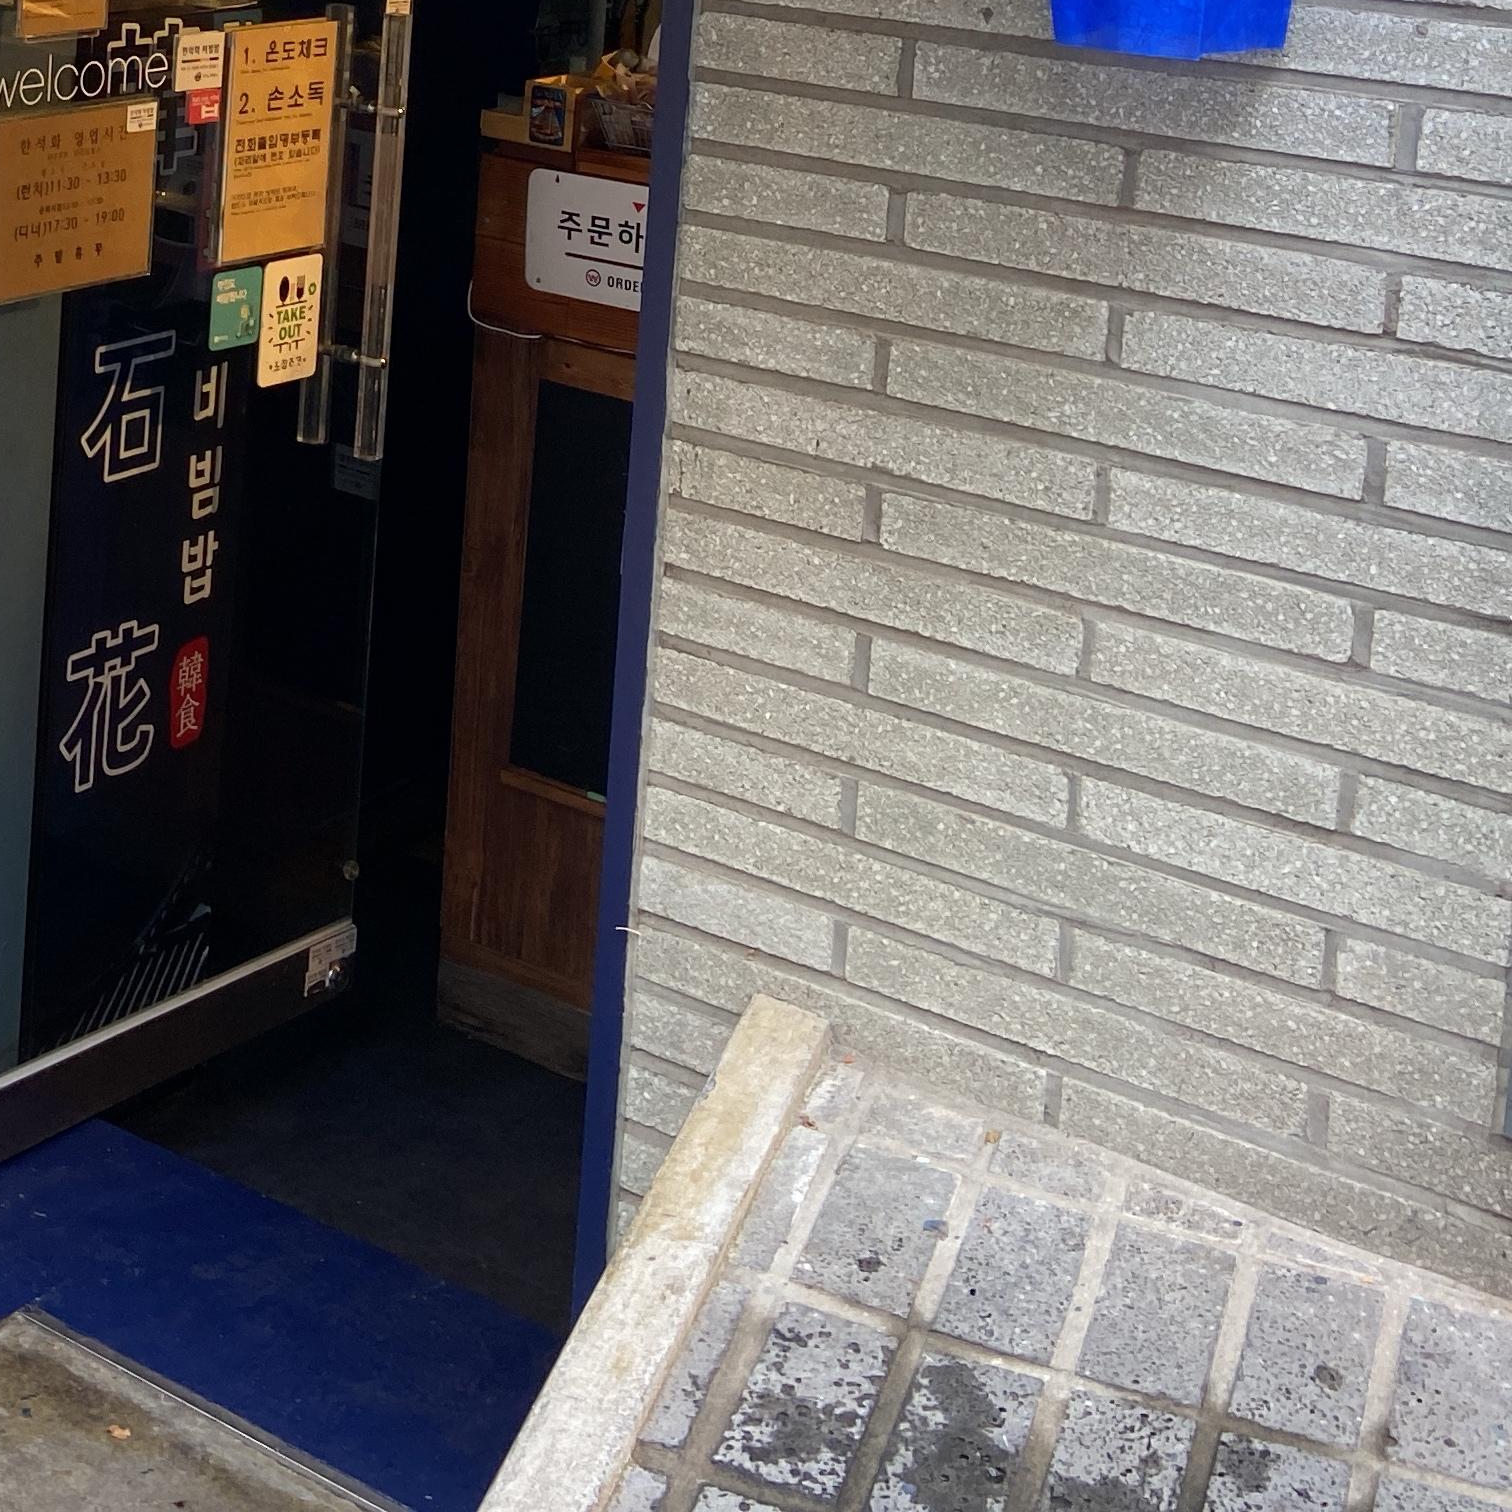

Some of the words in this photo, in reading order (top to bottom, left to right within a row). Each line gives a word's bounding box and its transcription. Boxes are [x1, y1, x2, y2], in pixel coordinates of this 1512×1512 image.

[265, 37, 328, 64] 온도체크
[267, 80, 325, 112] 손소독
[607, 275, 642, 294] ORDE
[276, 306, 307, 325] TAKE
[278, 323, 302, 341] OUT
[179, 361, 230, 605] 비빔밥
